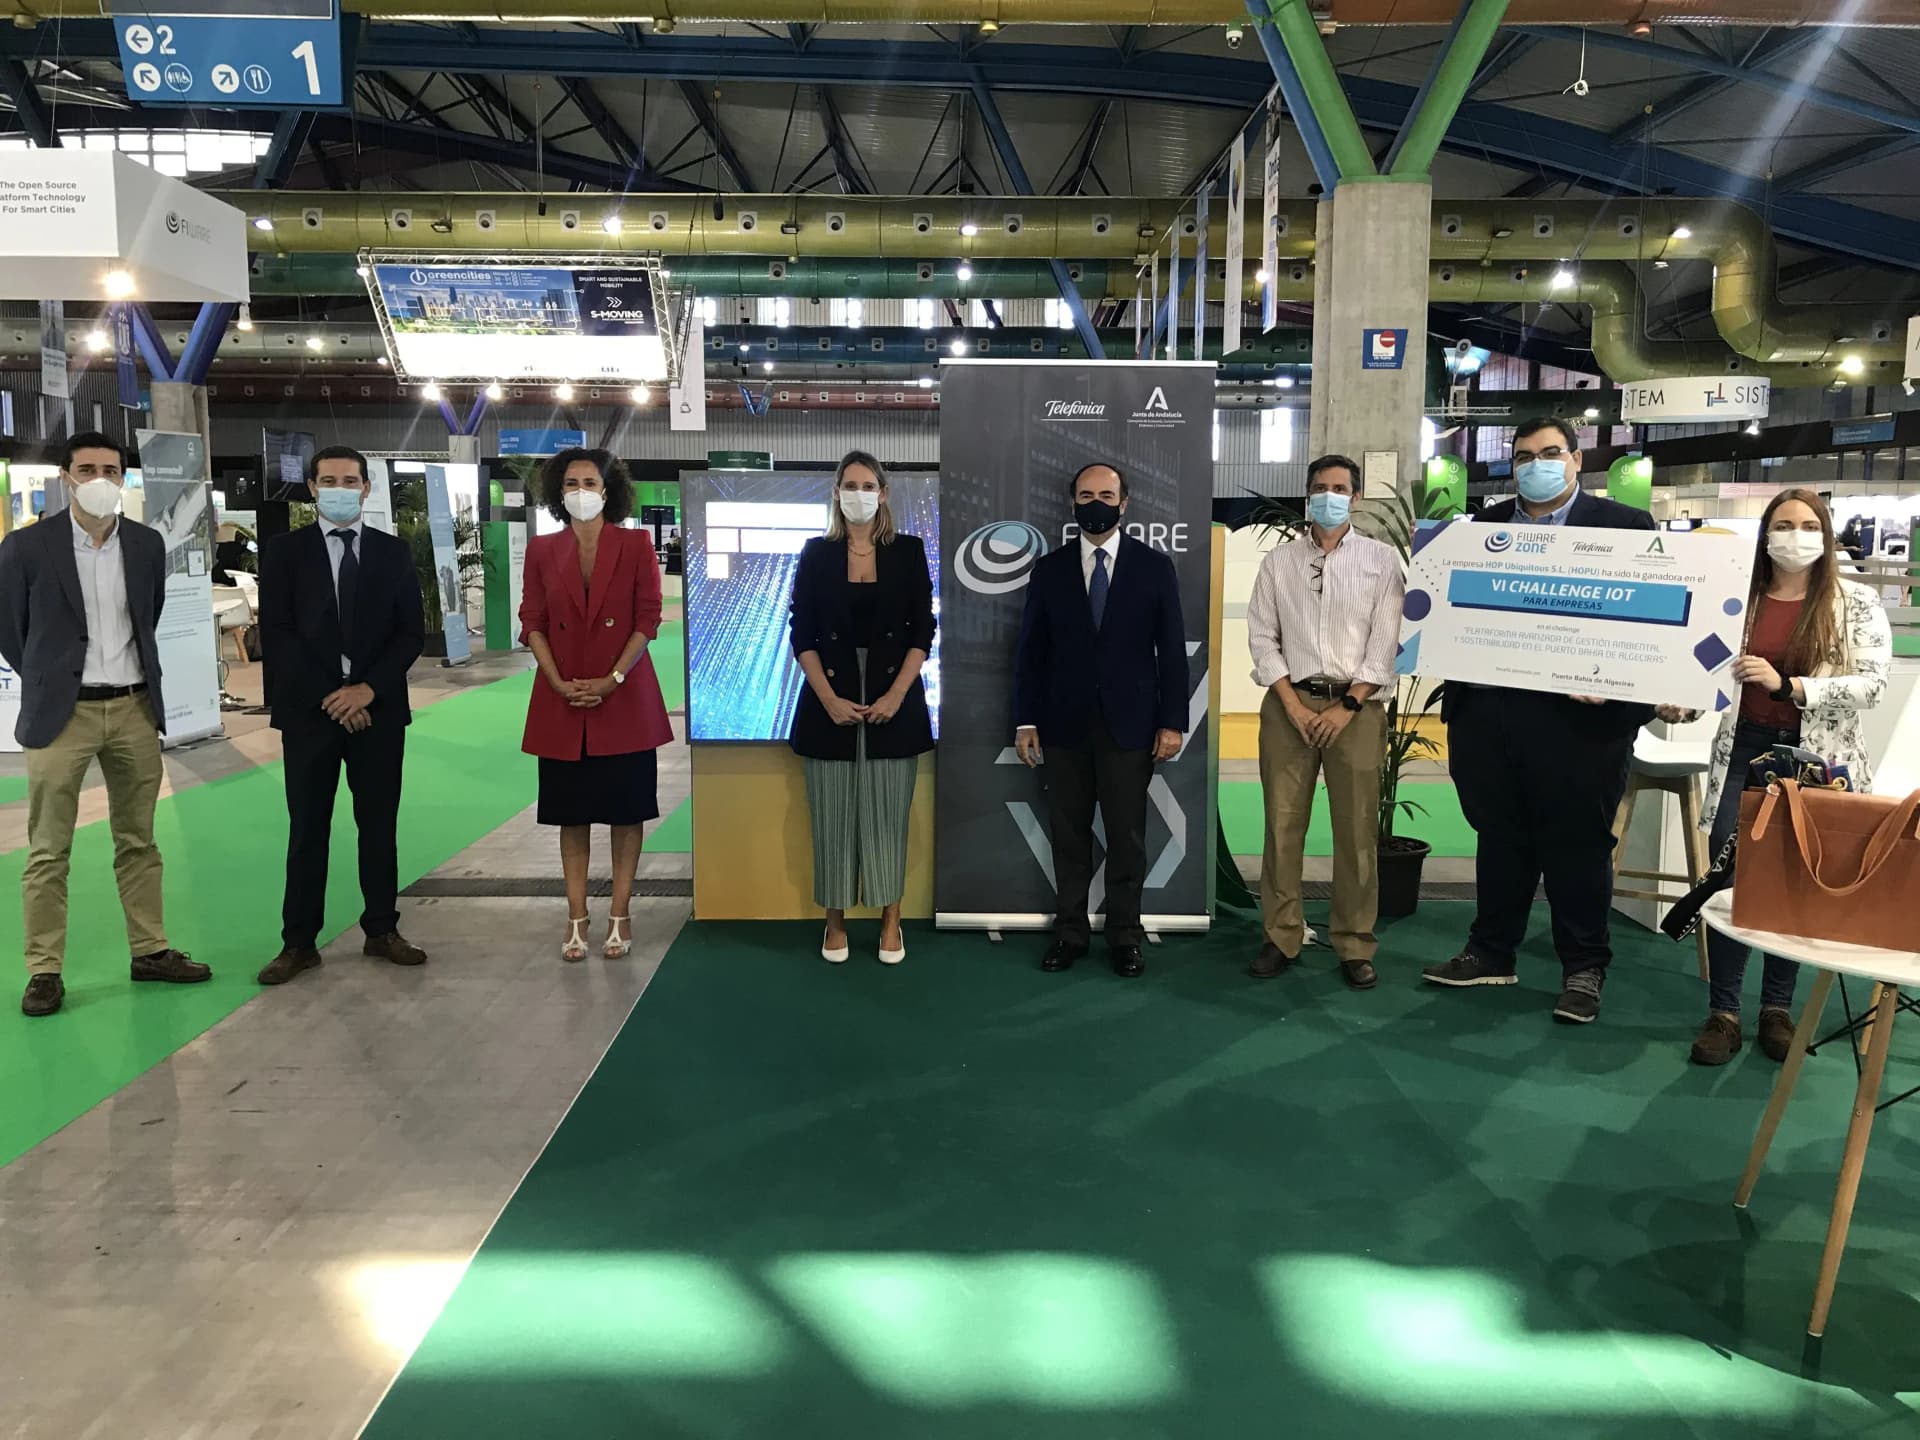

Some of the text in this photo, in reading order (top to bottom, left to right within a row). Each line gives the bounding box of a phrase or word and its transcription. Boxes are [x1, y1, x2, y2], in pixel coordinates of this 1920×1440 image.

[156, 25, 176, 55] 2
[291, 40, 321, 95] 1
[0, 181, 77, 190] The Open Source
[32, 193, 86, 203] Technology
[2, 205, 76, 214] For Smart Cities
[590, 310, 644, 319] S-MOVING
[1062, 522, 1188, 552] FARE
[1516, 531, 1557, 544] FIWARE
[1452, 560, 1484, 569] empresa
[1505, 562, 1549, 573] Ubiquitous
[1568, 566, 1600, 577] (HOPU)
[1601, 568, 1612, 577] ha
[1614, 569, 1631, 578] sido
[1641, 572, 1682, 582] ganadora
[1684, 575, 1695, 583] en
[1697, 574, 1706, 583] el
[1491, 578, 1636, 602] VI CHALLENGE IOT
[1522, 596, 1603, 610] PARA EMPRESAS
[1551, 625, 1580, 633] challenge
[1563, 635, 1574, 644] DE
[1534, 642, 1542, 651] EL
[1544, 644, 1577, 655] PUERTO
[1605, 650, 1616, 659] DE
[1551, 672, 1573, 681] Puerto
[1604, 677, 1635, 688] Algeciras
